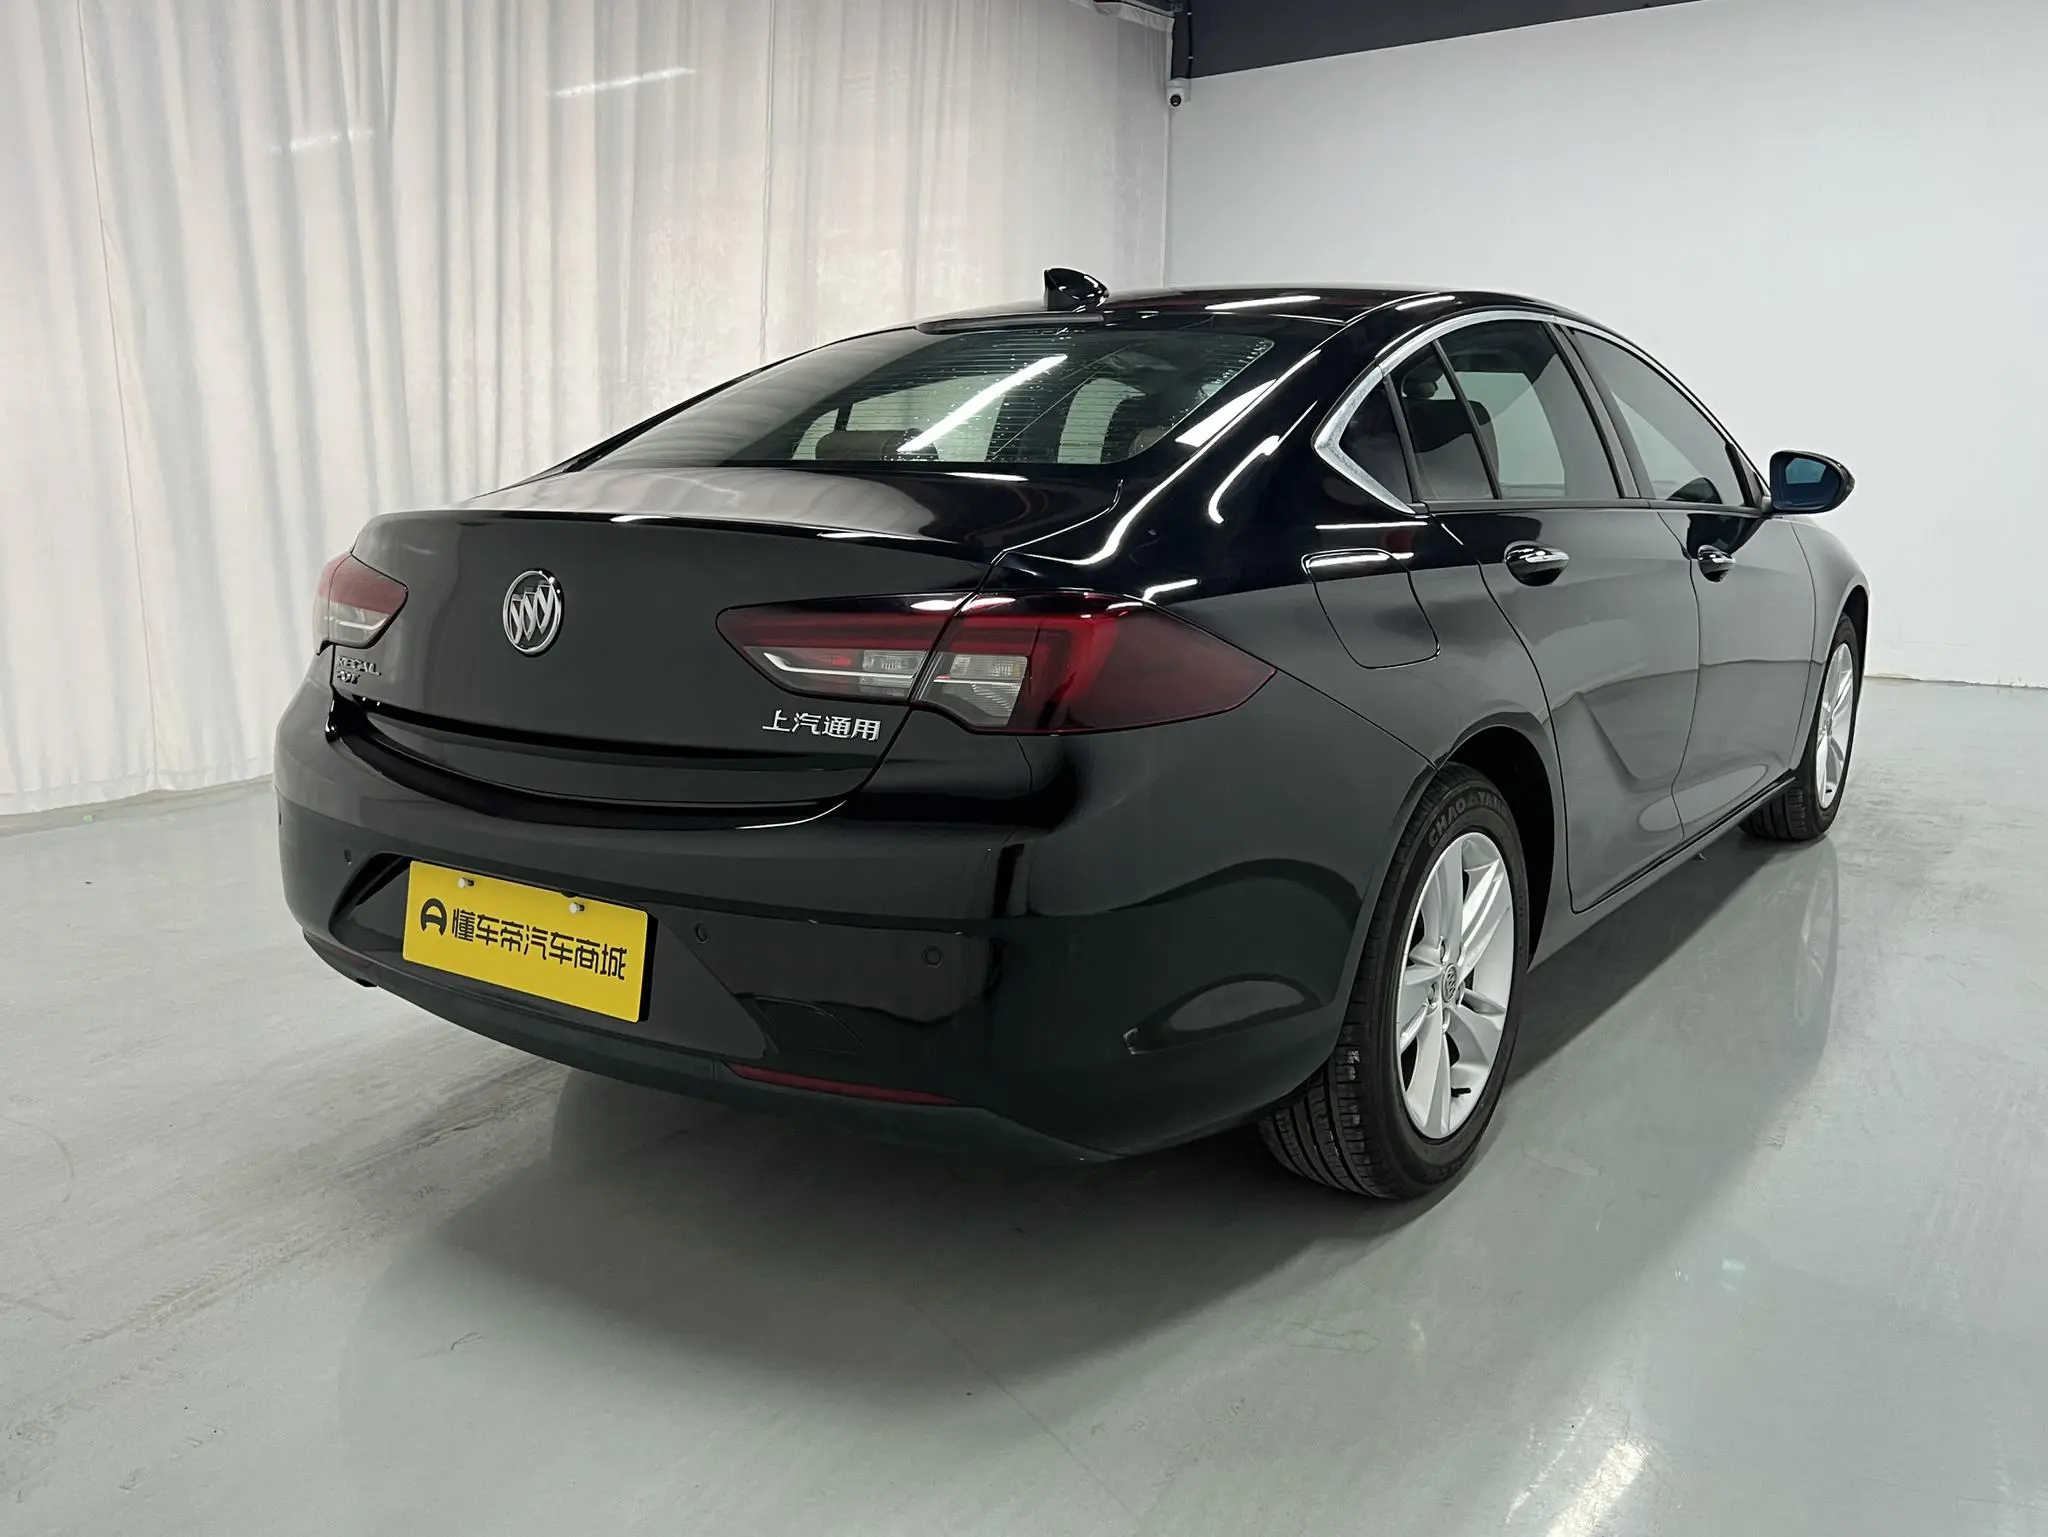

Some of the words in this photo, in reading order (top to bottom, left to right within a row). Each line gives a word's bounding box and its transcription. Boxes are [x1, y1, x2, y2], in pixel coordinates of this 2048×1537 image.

[762, 709, 881, 741] 上汽通用
[451, 907, 628, 981] 懂车帝汽车商城
